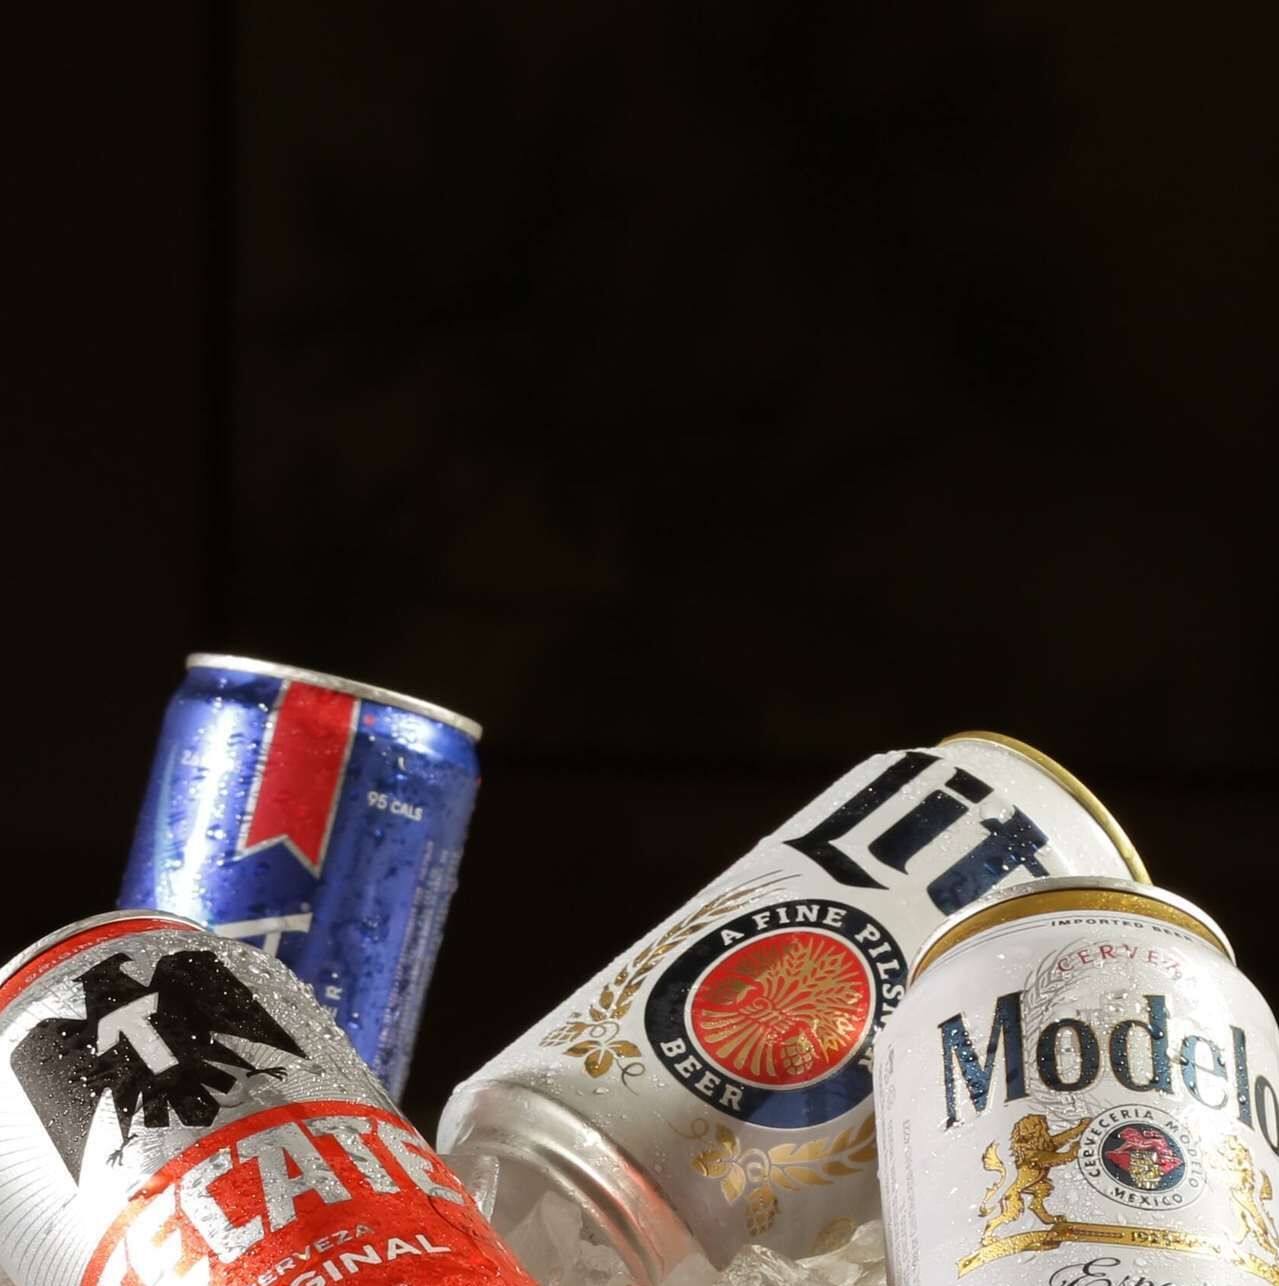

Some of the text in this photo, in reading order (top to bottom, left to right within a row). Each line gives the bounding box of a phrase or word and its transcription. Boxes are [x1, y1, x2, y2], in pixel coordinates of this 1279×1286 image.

[368, 791, 424, 822] 95 CALS
[783, 750, 1050, 916] Lit
[751, 903, 848, 932] FINE
[1050, 917, 1195, 944] IMPORTED BEER
[719, 927, 745, 949] A
[659, 1036, 746, 1112] BEER
[1083, 1108, 1203, 1189] CERVECERIA MODELO
[1112, 1186, 1183, 1208] MEXICO
